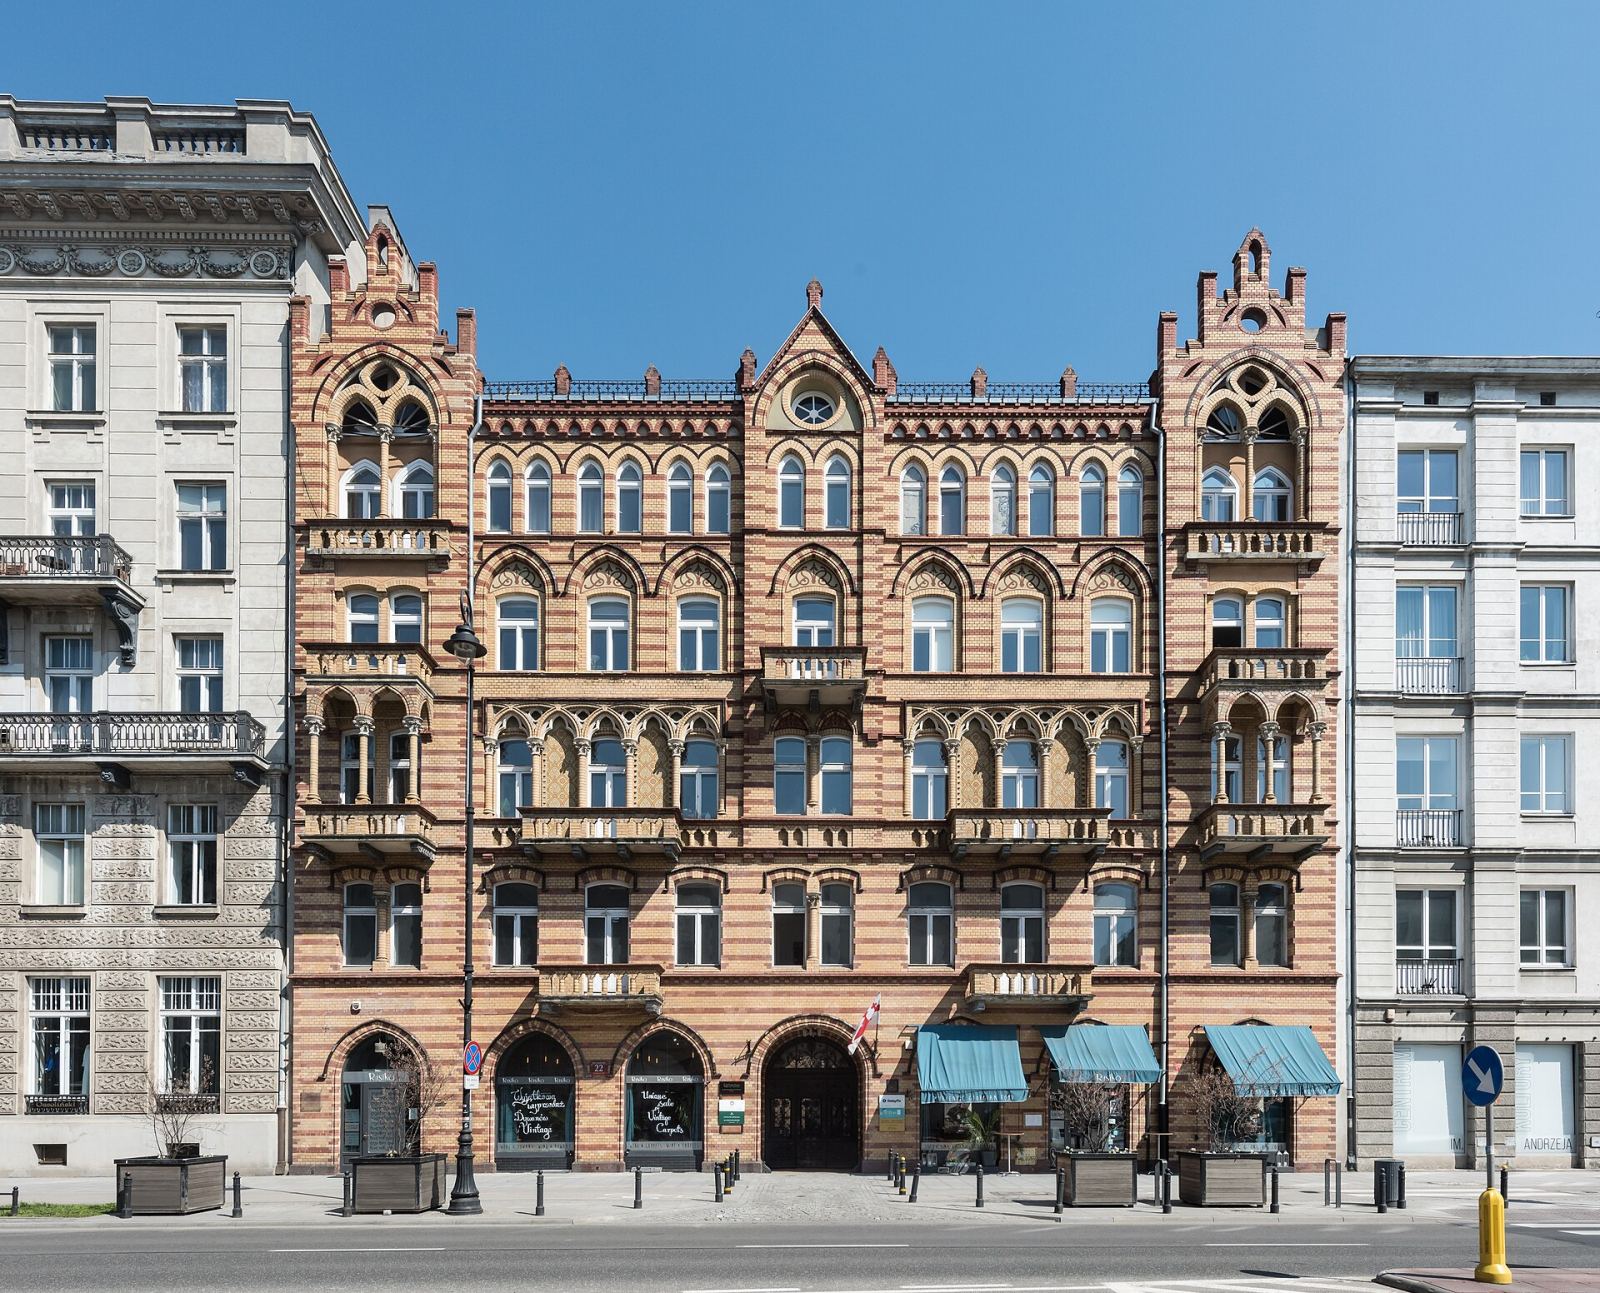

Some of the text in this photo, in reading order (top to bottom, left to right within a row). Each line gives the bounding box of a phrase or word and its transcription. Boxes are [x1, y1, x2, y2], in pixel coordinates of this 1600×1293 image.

[594, 1064, 604, 1072] 22
[641, 1090, 667, 1099] Unique
[657, 1098, 675, 1107] sale
[647, 1110, 672, 1126] Vintage
[519, 1122, 553, 1140] Vintage
[656, 1122, 684, 1136] Carpets
[1450, 1138, 1464, 1150] IM.
[1524, 1138, 1573, 1150] ANDRZEJA
